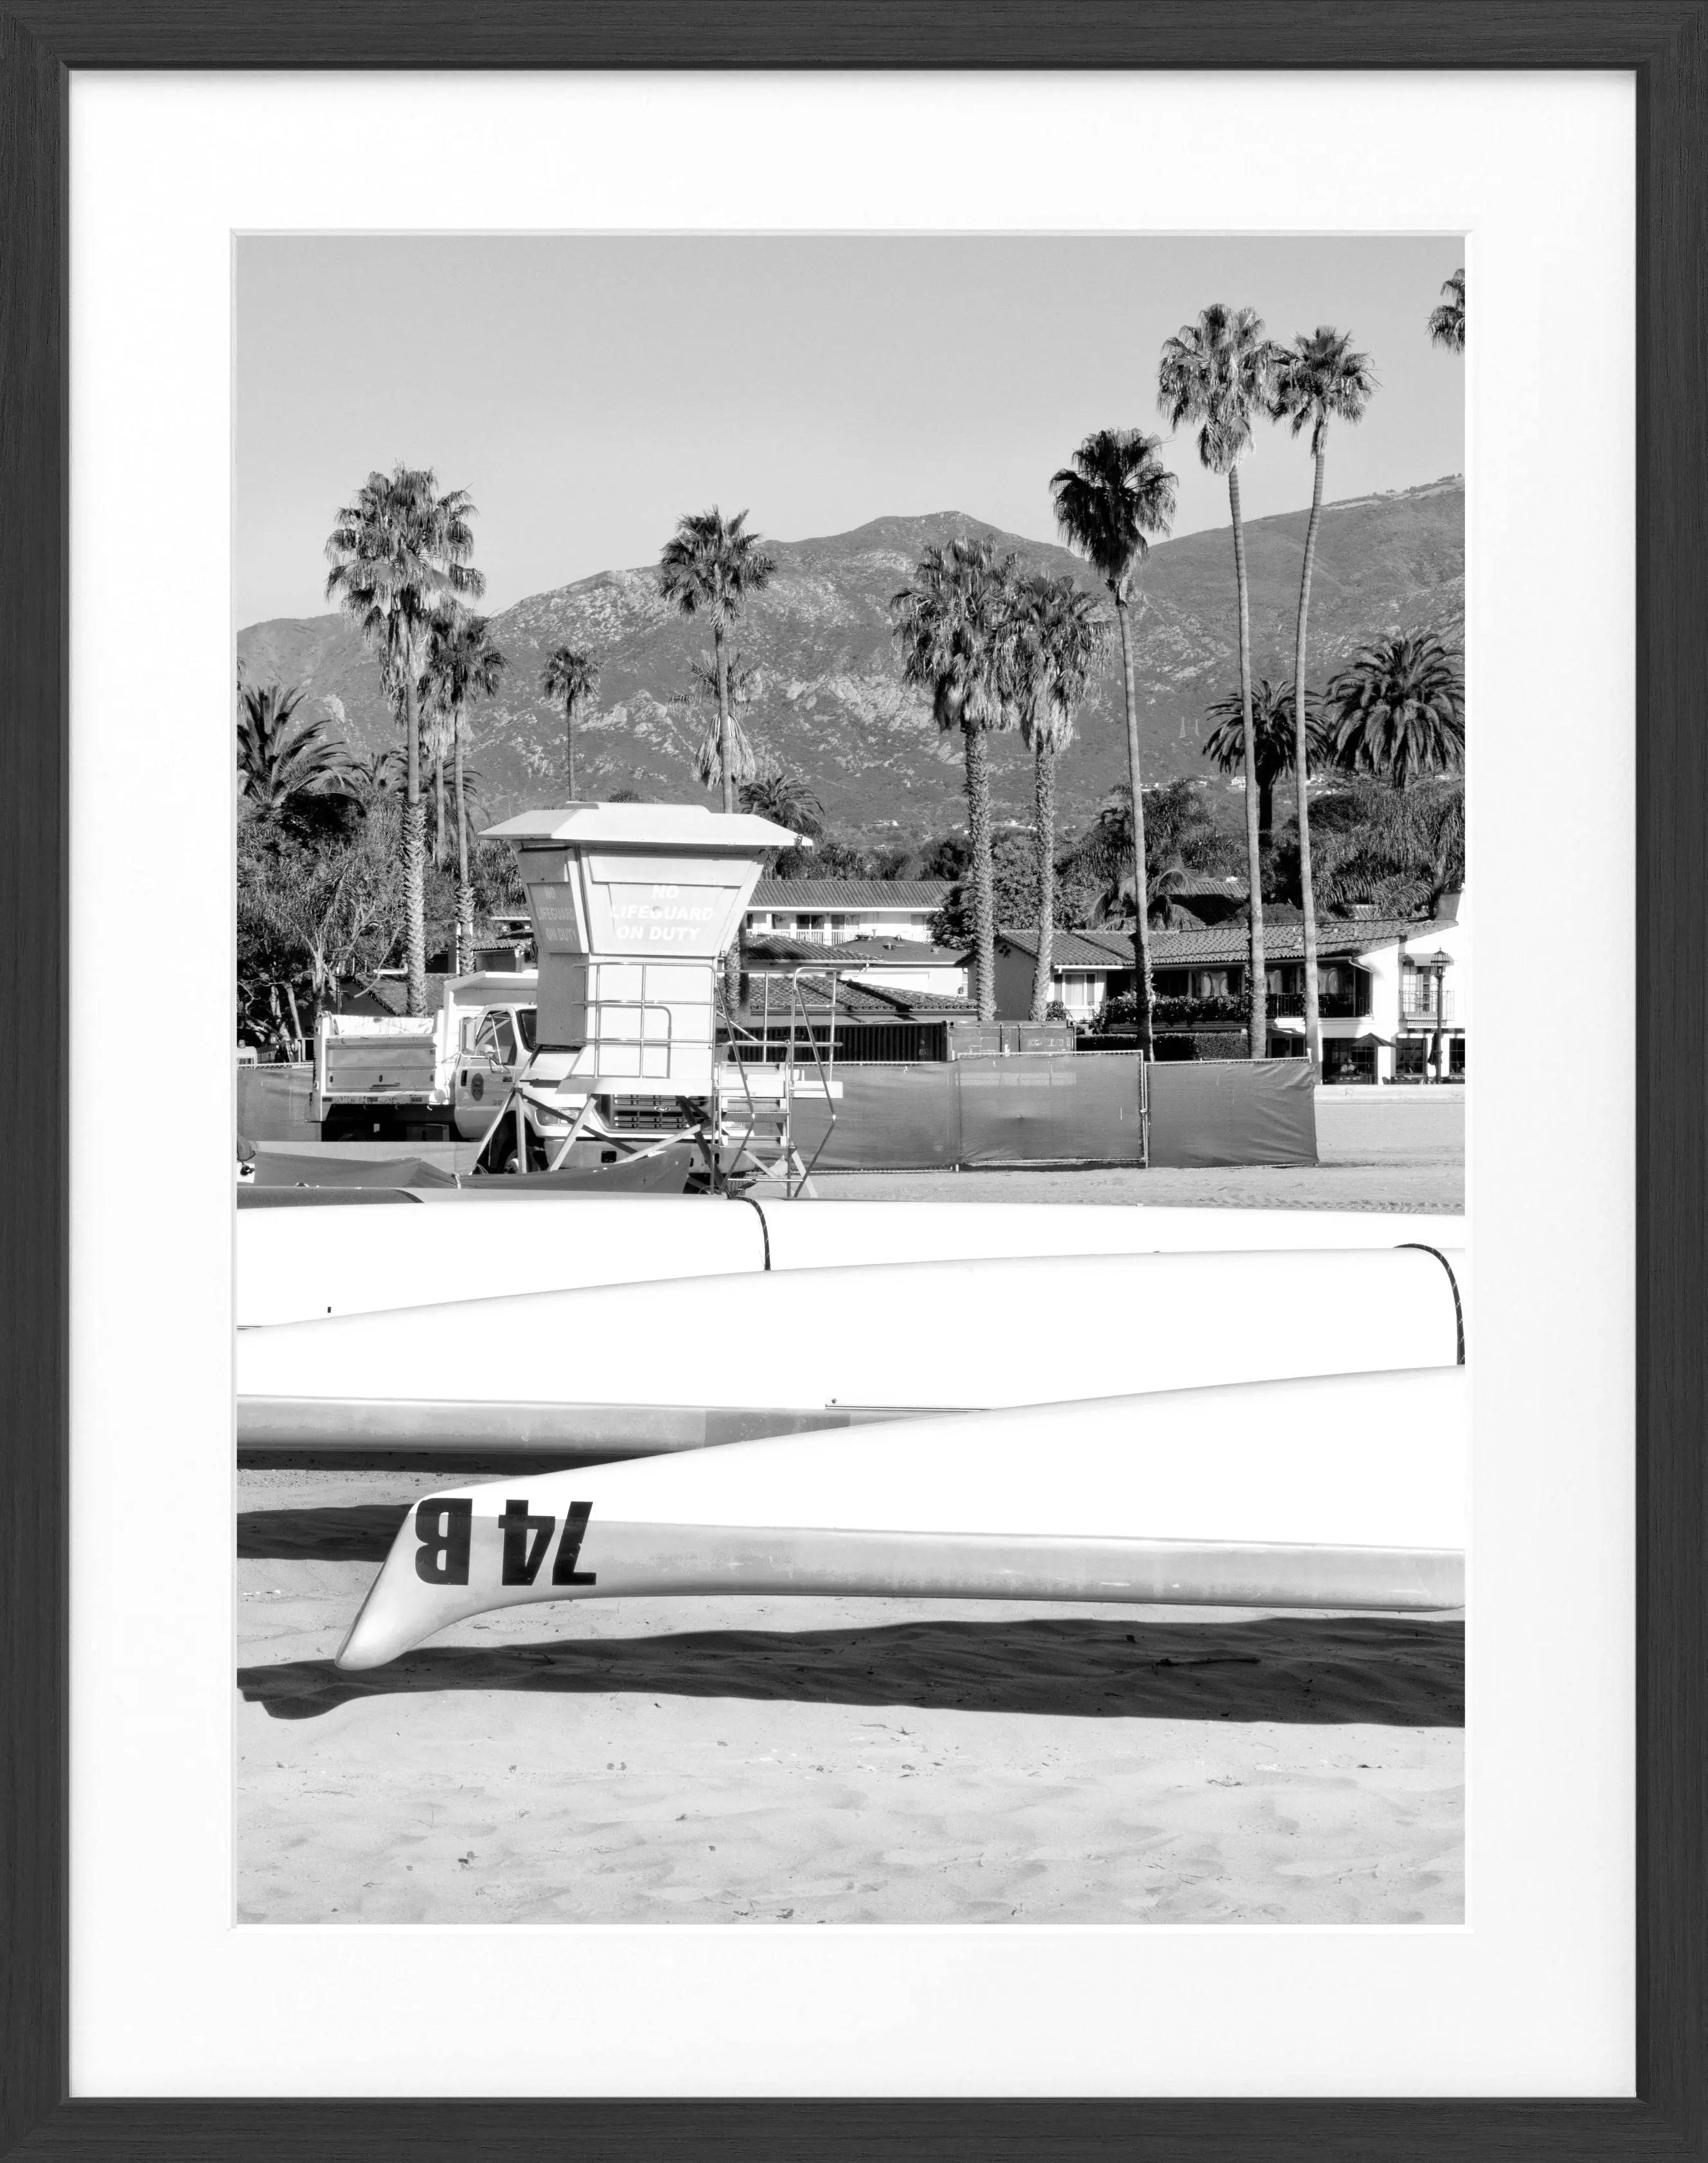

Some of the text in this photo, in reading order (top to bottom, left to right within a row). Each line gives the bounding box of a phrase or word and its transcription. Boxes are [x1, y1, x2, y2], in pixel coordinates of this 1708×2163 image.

[544, 886, 556, 900] NO
[652, 885, 681, 899] NO
[610, 904, 714, 921] LIFEGUARD
[545, 927, 557, 941] ON
[616, 925, 702, 941] ON DUTY
[414, 1497, 597, 1587] 74 B
